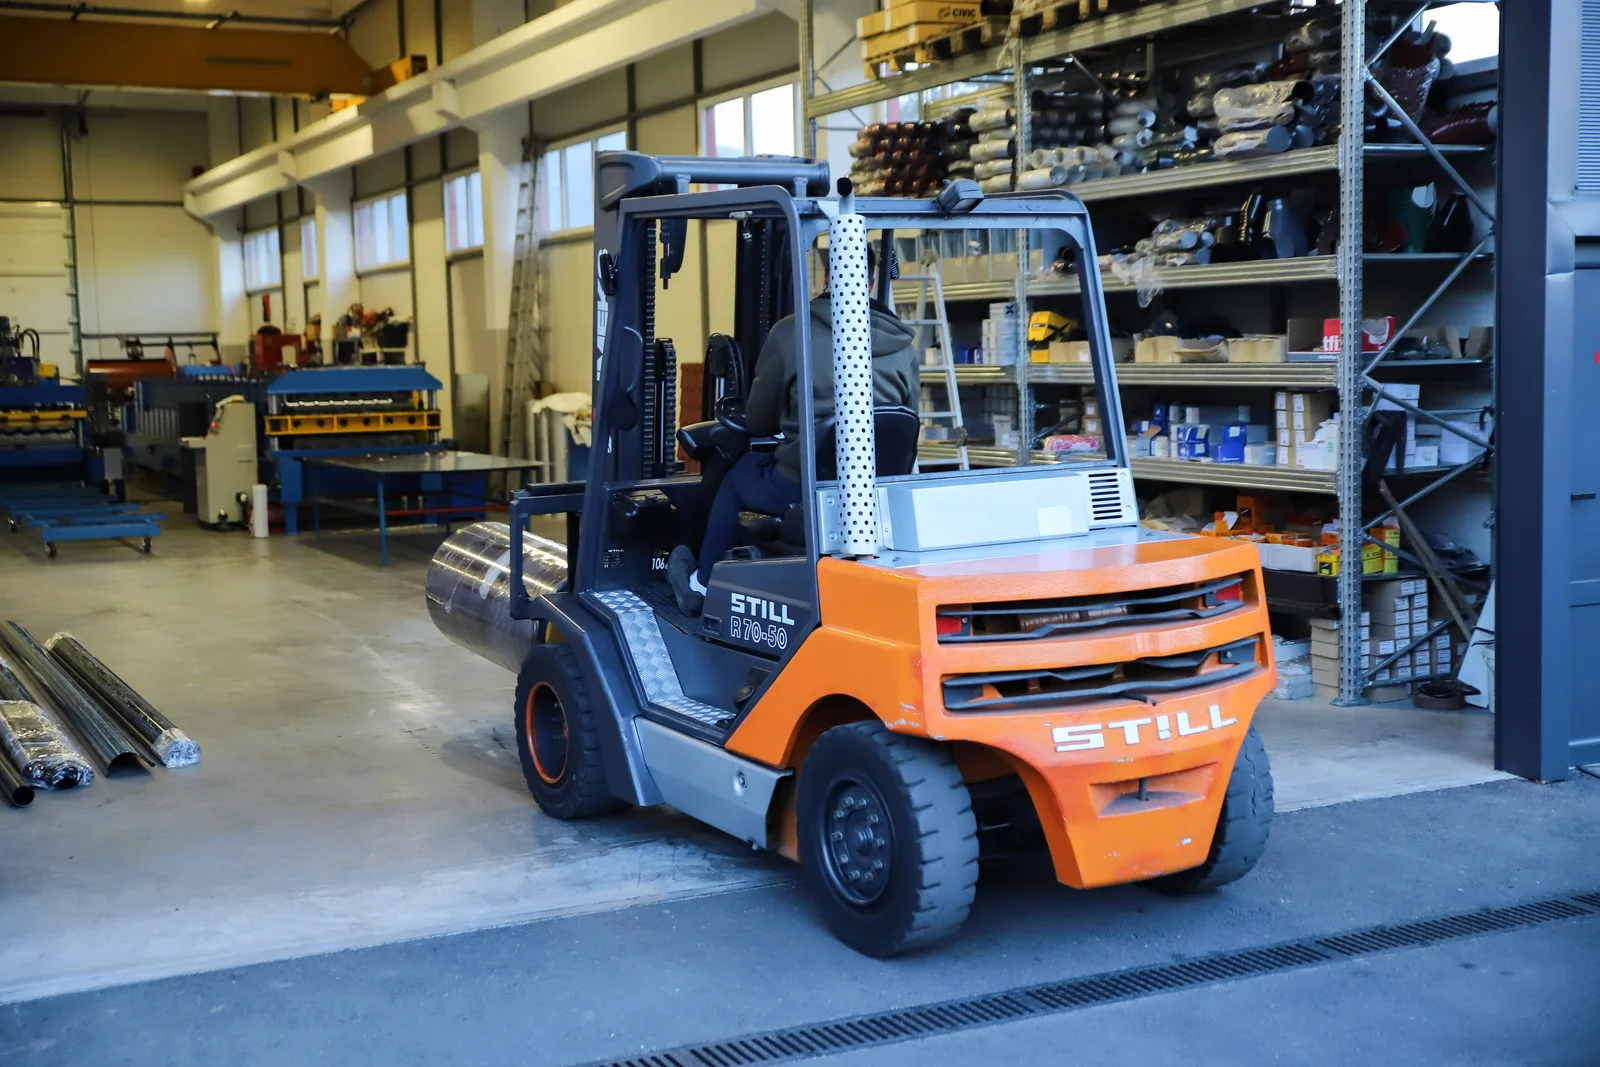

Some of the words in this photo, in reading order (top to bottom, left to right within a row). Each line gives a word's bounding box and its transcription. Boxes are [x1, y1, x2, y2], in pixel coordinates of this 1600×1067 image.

[952, 8, 976, 17] CIVIC
[731, 592, 795, 626] STILL
[730, 615, 742, 639] R
[743, 618, 788, 650] 70-50
[1052, 704, 1238, 753] STILL
